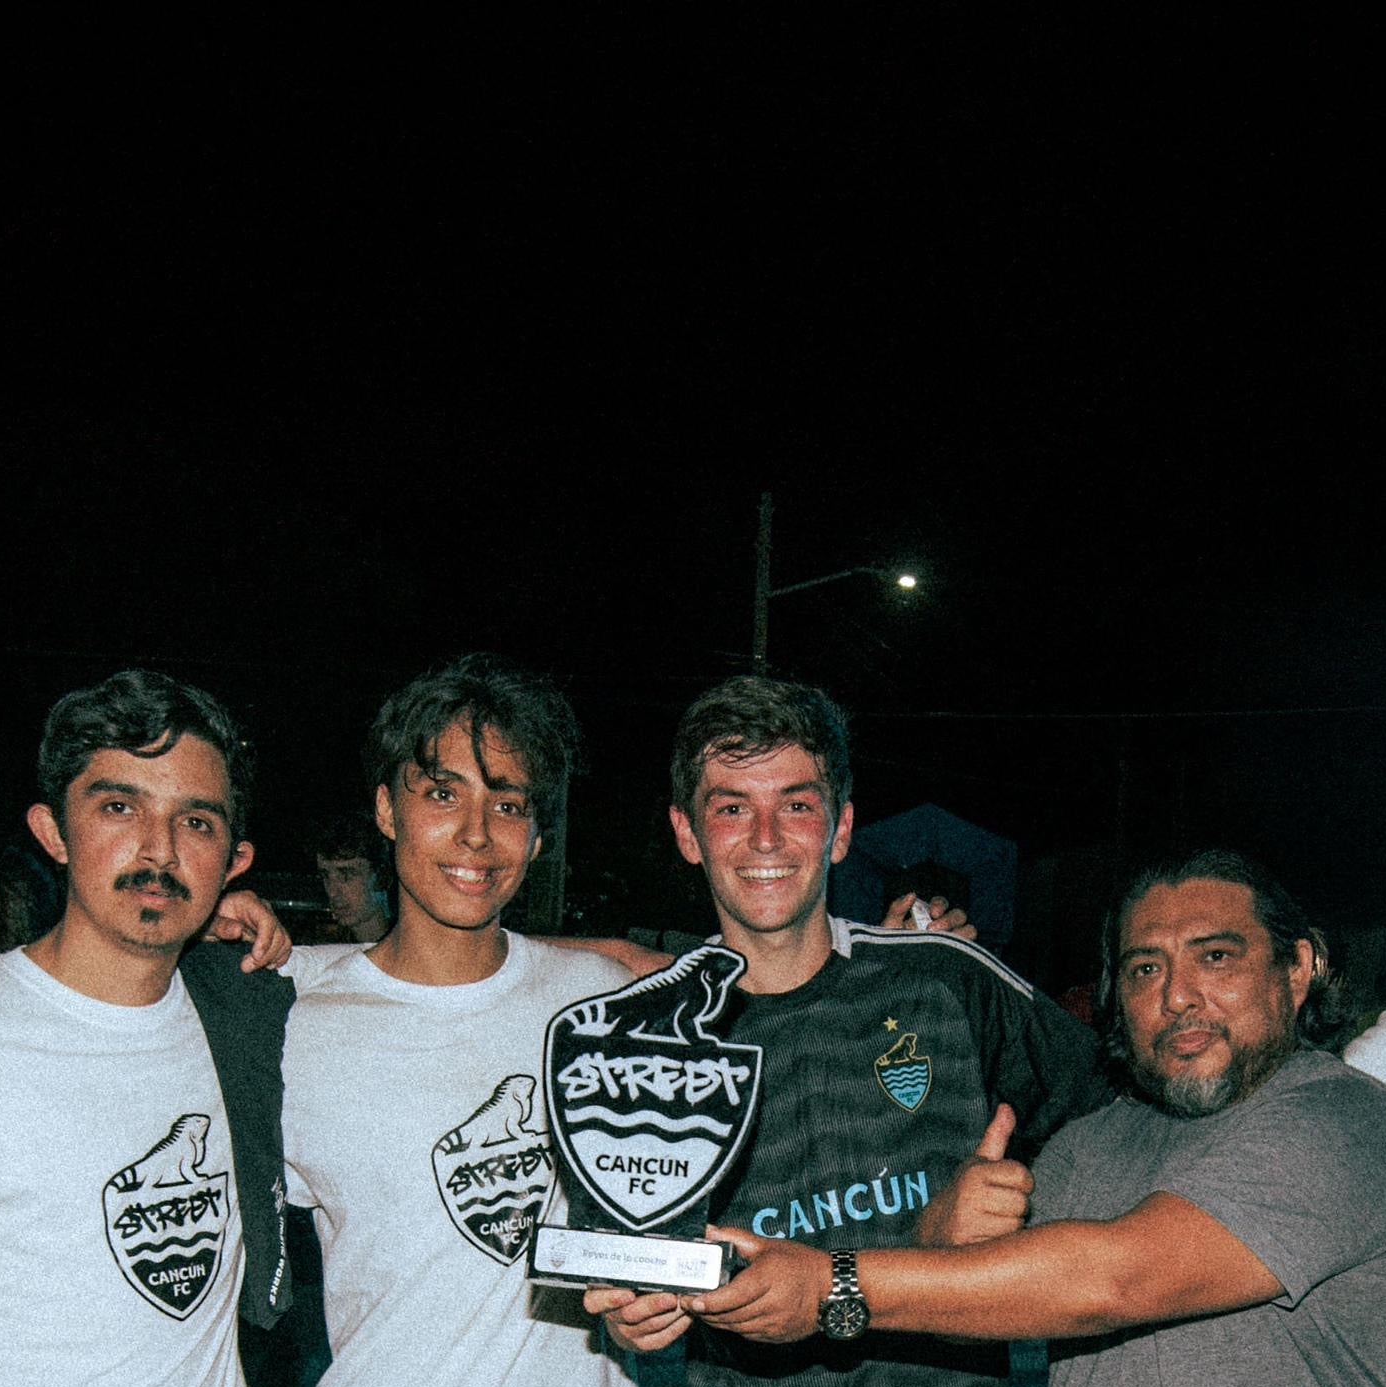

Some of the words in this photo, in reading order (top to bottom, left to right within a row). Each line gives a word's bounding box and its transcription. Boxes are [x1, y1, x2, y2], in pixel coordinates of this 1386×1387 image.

[557, 1051, 751, 1107] STREET
[628, 1177, 656, 1196] FC
[752, 1167, 930, 1240] CANCÚN
[113, 1187, 222, 1239] STREET
[173, 1281, 191, 1297] FC
[269, 1258, 286, 1307] WORKS
